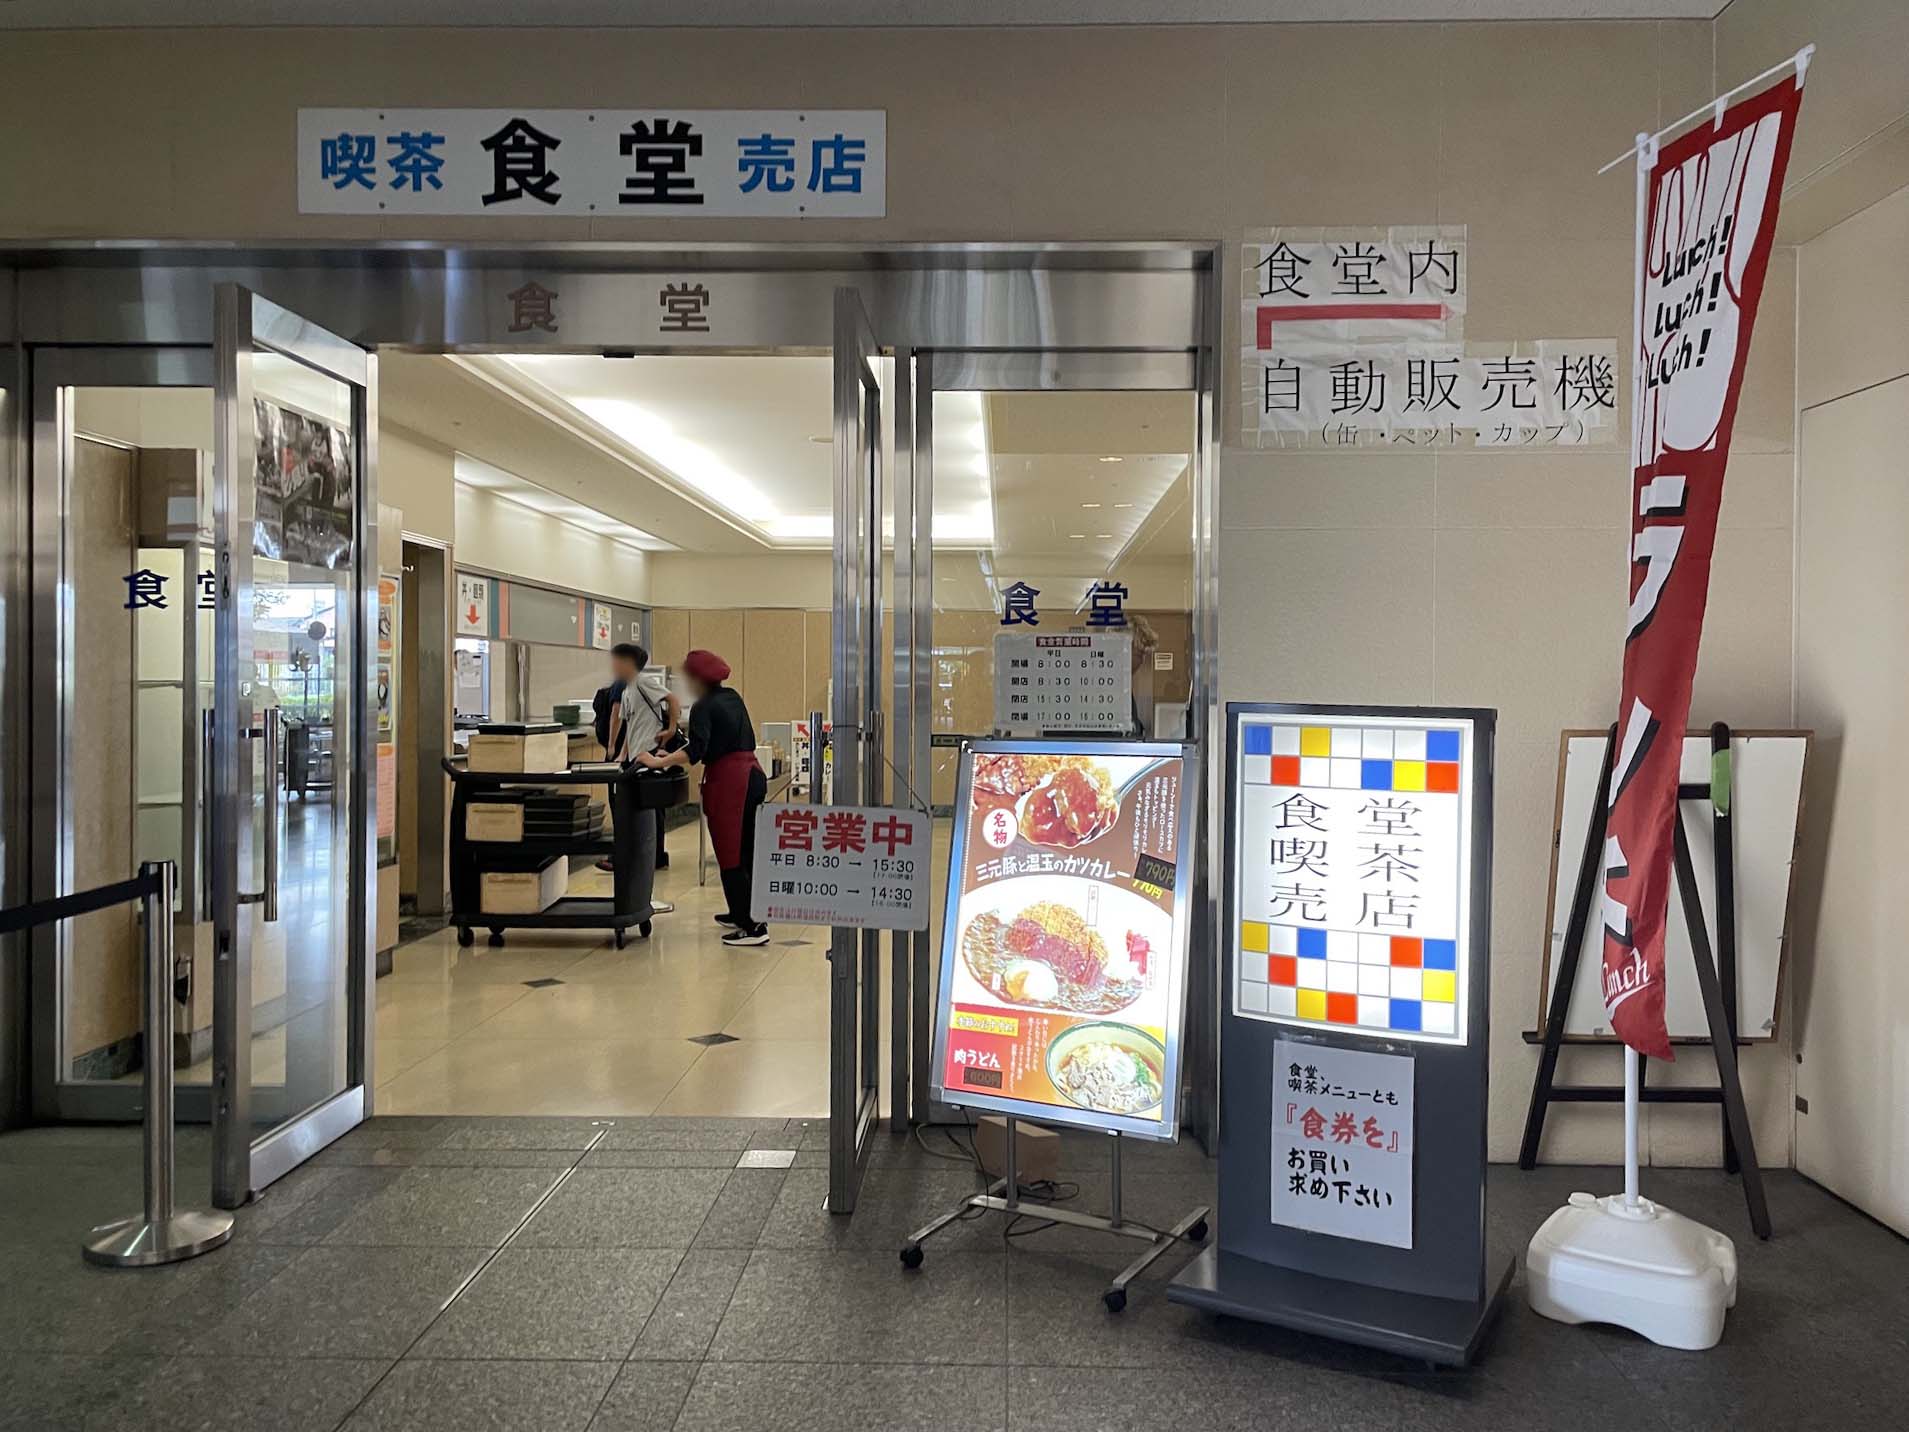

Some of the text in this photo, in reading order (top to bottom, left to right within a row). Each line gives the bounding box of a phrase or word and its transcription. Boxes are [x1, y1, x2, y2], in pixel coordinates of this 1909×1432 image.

[320, 118, 866, 207] 喫茶 食堂 売店
[1254, 239, 1459, 299] 食堂内
[507, 282, 711, 333] 食堂
[1262, 354, 1616, 415] 自動販売機
[1000, 581, 1129, 626] 食堂
[775, 808, 913, 857] 営業中
[993, 813, 1007, 844] 名物
[1271, 792, 1423, 837] 食堂
[770, 853, 914, 873] 平日 8:30 15:30
[975, 853, 1131, 882] 三元豚と温玉のカツカレー
[1270, 837, 1424, 882] 喫茶
[871, 886, 912, 901] 14:30
[1269, 882, 1422, 929] 売店
[953, 1048, 1001, 1068] 肉うどん
[1288, 1062, 1326, 1081] 食堂、
[1287, 1079, 1399, 1106] 喫茶メニューとも
[1286, 1102, 1399, 1153] 『食券を』
[1287, 1146, 1349, 1176] お買い
[1287, 1171, 1393, 1209] 求め下さい
